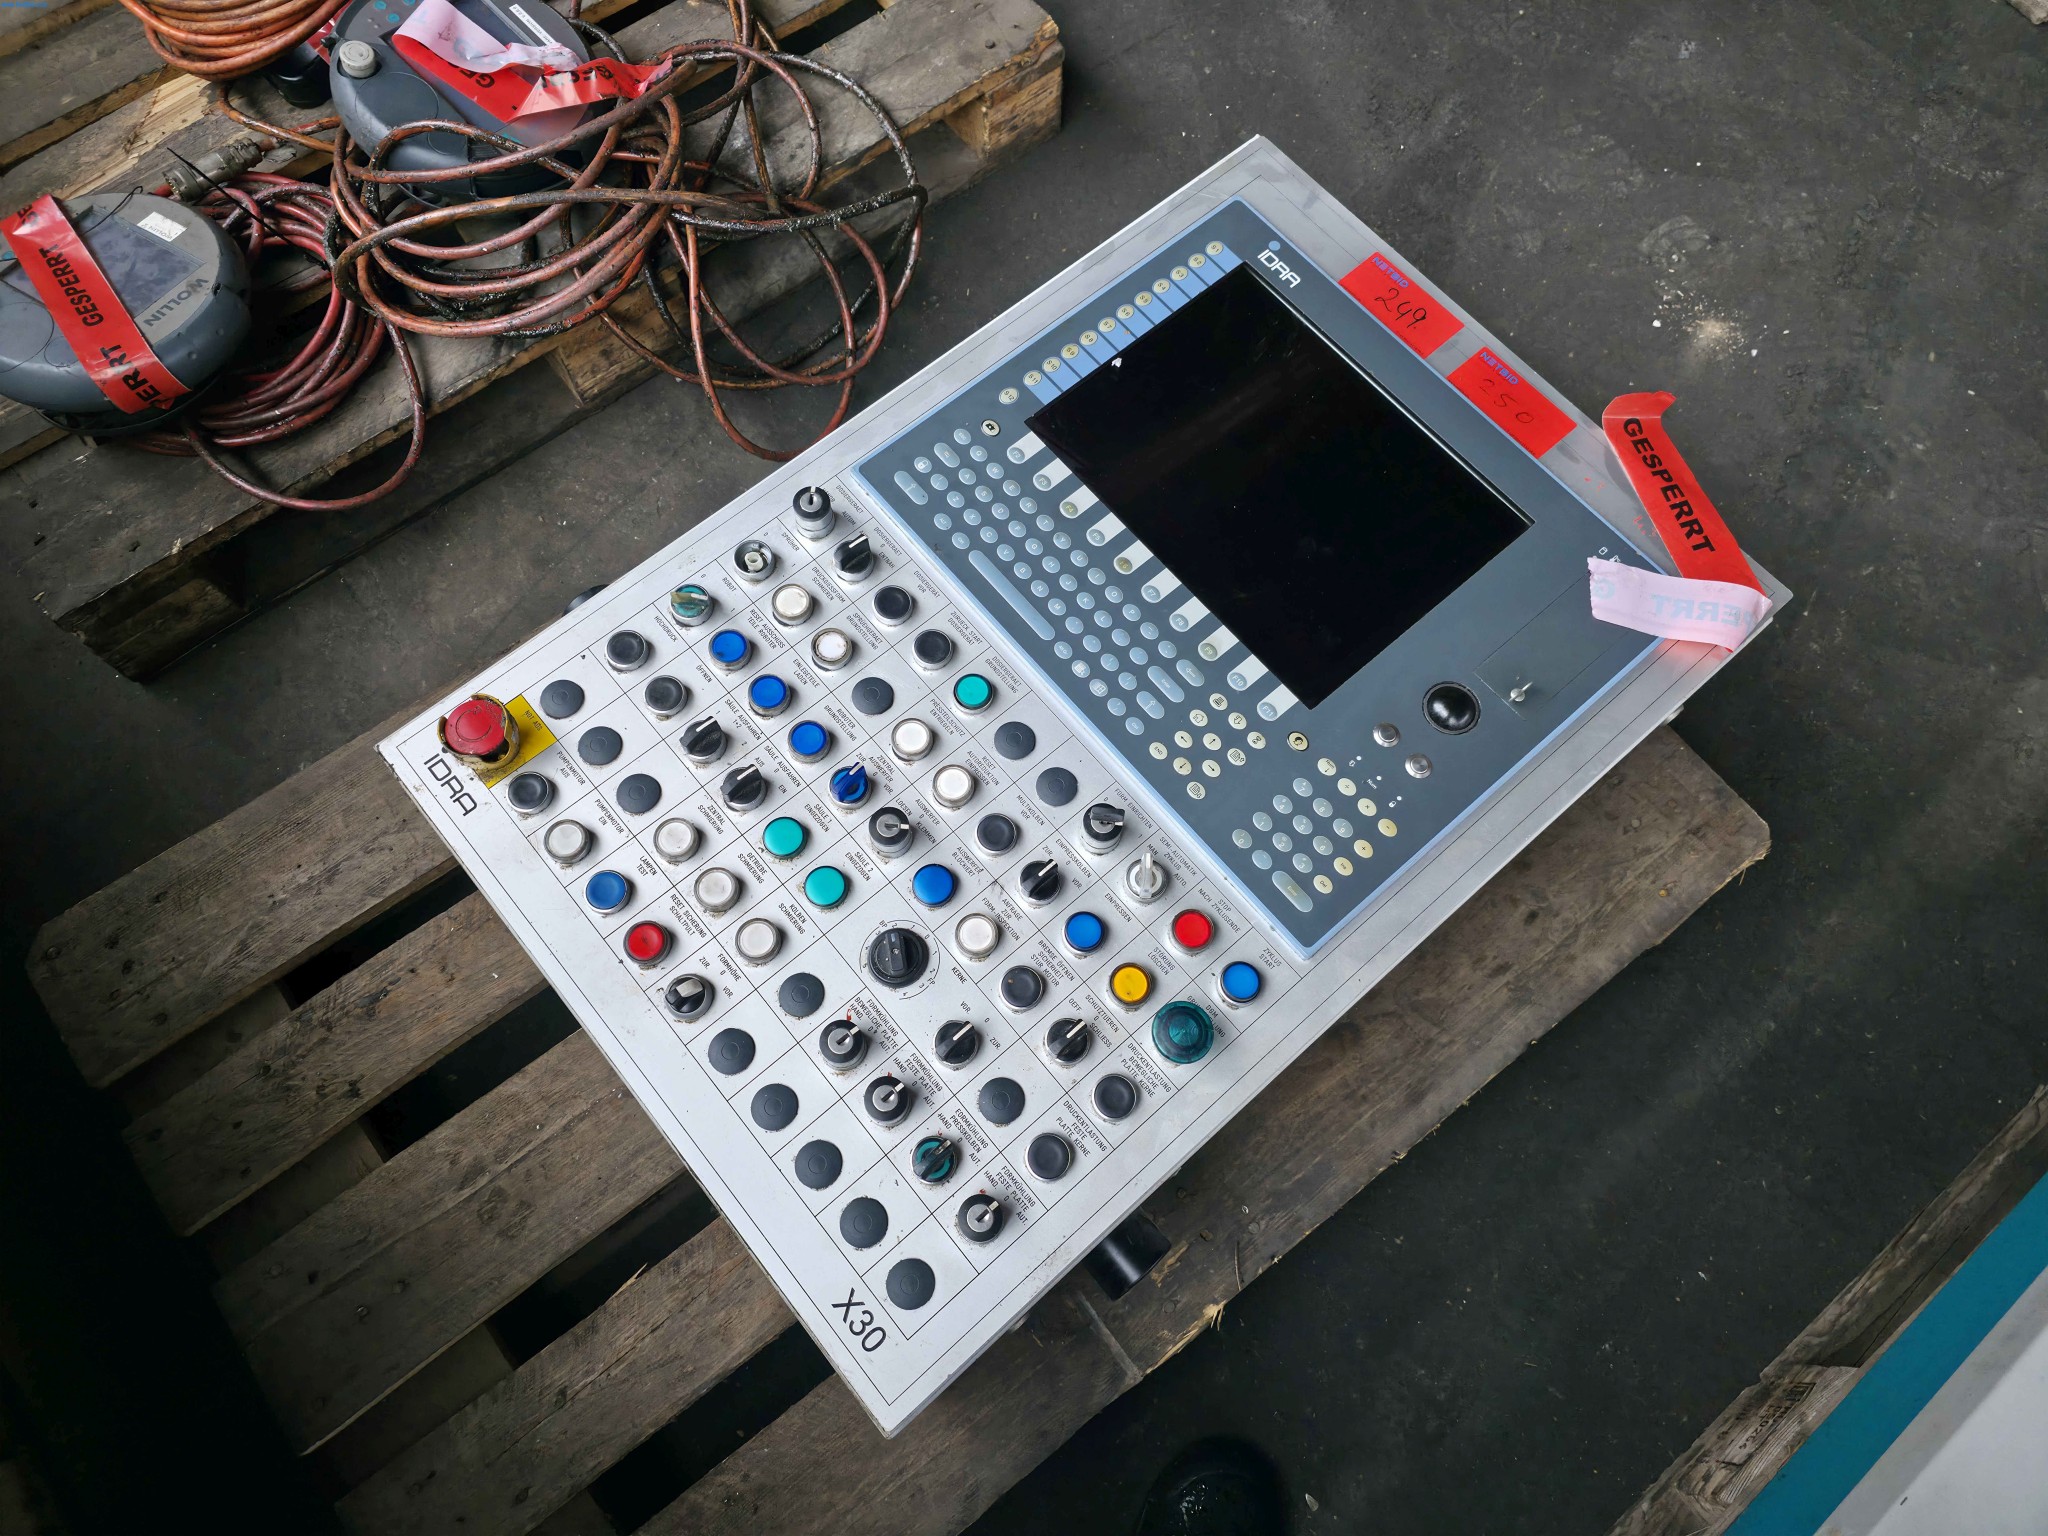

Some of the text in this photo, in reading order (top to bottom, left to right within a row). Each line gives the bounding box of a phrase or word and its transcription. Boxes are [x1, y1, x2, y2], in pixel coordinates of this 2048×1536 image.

[38, 244, 104, 327] GESPERRT
[143, 278, 209, 327] WOLLIN
[1370, 256, 1409, 289] NETBID
[99, 344, 175, 409] ERRT
[1479, 351, 1519, 386] NETBID
[1475, 375, 1536, 428] 250
[1623, 417, 1716, 553] GESPERRT
[423, 752, 478, 817] IDRA
[830, 1285, 890, 1356] X30
